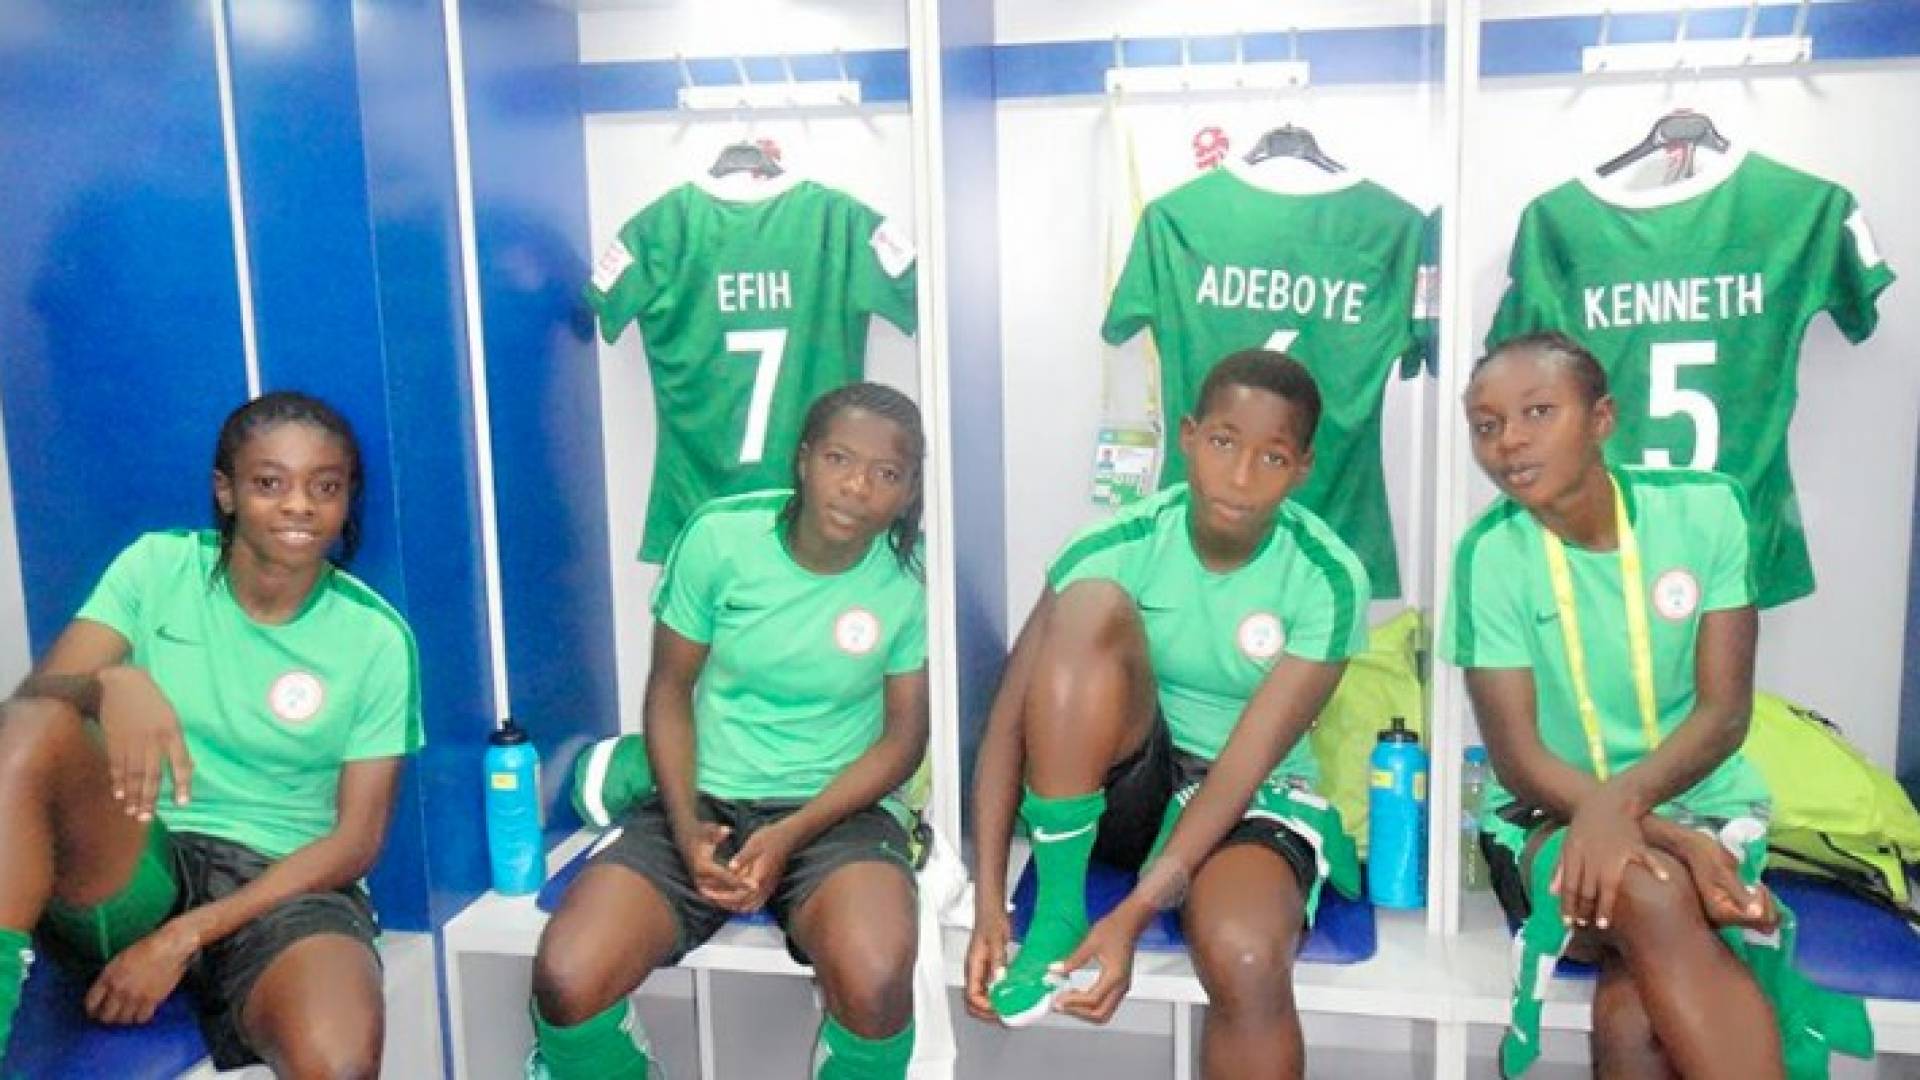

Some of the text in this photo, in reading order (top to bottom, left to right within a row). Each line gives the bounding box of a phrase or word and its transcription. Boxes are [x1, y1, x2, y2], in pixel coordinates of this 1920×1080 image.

[718, 271, 791, 312] EFIH
[1197, 265, 1367, 323] ADEBOYE
[1584, 272, 1763, 330] KENNETH
[725, 330, 788, 463] 7
[1642, 341, 1721, 469] 5
